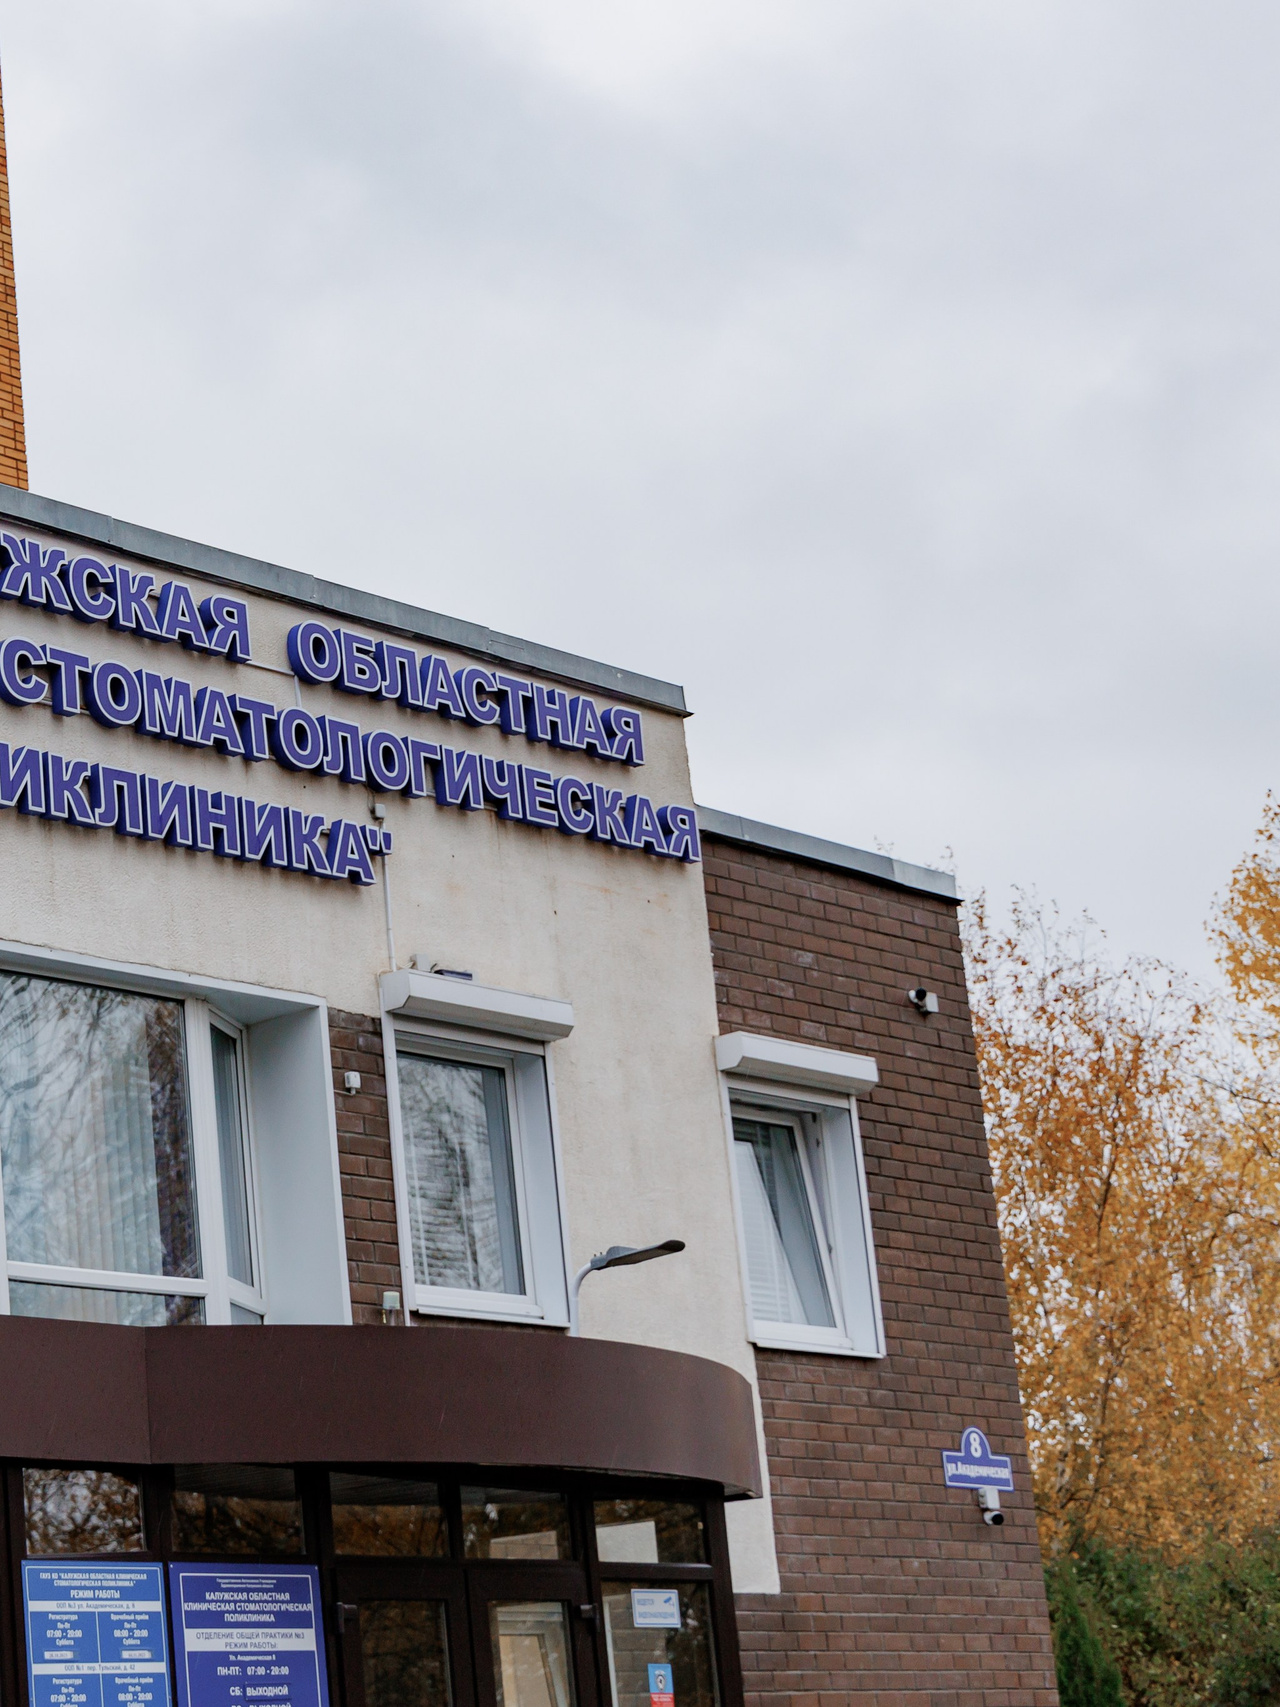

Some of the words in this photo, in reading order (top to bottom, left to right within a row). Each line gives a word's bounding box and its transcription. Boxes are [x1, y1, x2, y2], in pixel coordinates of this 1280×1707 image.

[287, 620, 645, 767] ОБЛАСТНАЯ
[969, 1432, 982, 1458] 8
[70, 1590, 94, 1599] РЕЖИМ
[94, 1590, 121, 1599] РАБОТЫ
[206, 1592, 248, 1600] КАЛУЖСКАЯ
[248, 1592, 290, 1600] ОБЛАСТНАЯ
[184, 1602, 235, 1611] КЛИНИЧЕСКАЯ
[236, 1602, 312, 1612] СТОМАТОЛОГИЧЕСКАЯ
[224, 1614, 275, 1622] ПОЛИКЛИНИКА
[46, 1630, 62, 1638] 07:00
[67, 1630, 82, 1638] 20:00
[134, 1630, 148, 1638] 20:00
[196, 1632, 234, 1640] ОТДЕЛЕНИЕ
[236, 1631, 260, 1640] ОБЩЕЙ
[261, 1632, 294, 1640] ПРАКТИКИ
[294, 1632, 304, 1640] №3
[224, 1642, 248, 1650] РЕЖИМ
[217, 1666, 242, 1676] ПН-ПТ:
[246, 1666, 266, 1676] 07:00
[270, 1666, 289, 1675] 20:00
[230, 1686, 243, 1696] СБ:
[246, 1685, 288, 1697] ВЫХОДНОЙ
[50, 1694, 66, 1702] 07:00
[72, 1694, 87, 1702] 20:00
[138, 1693, 152, 1701] 20:00
